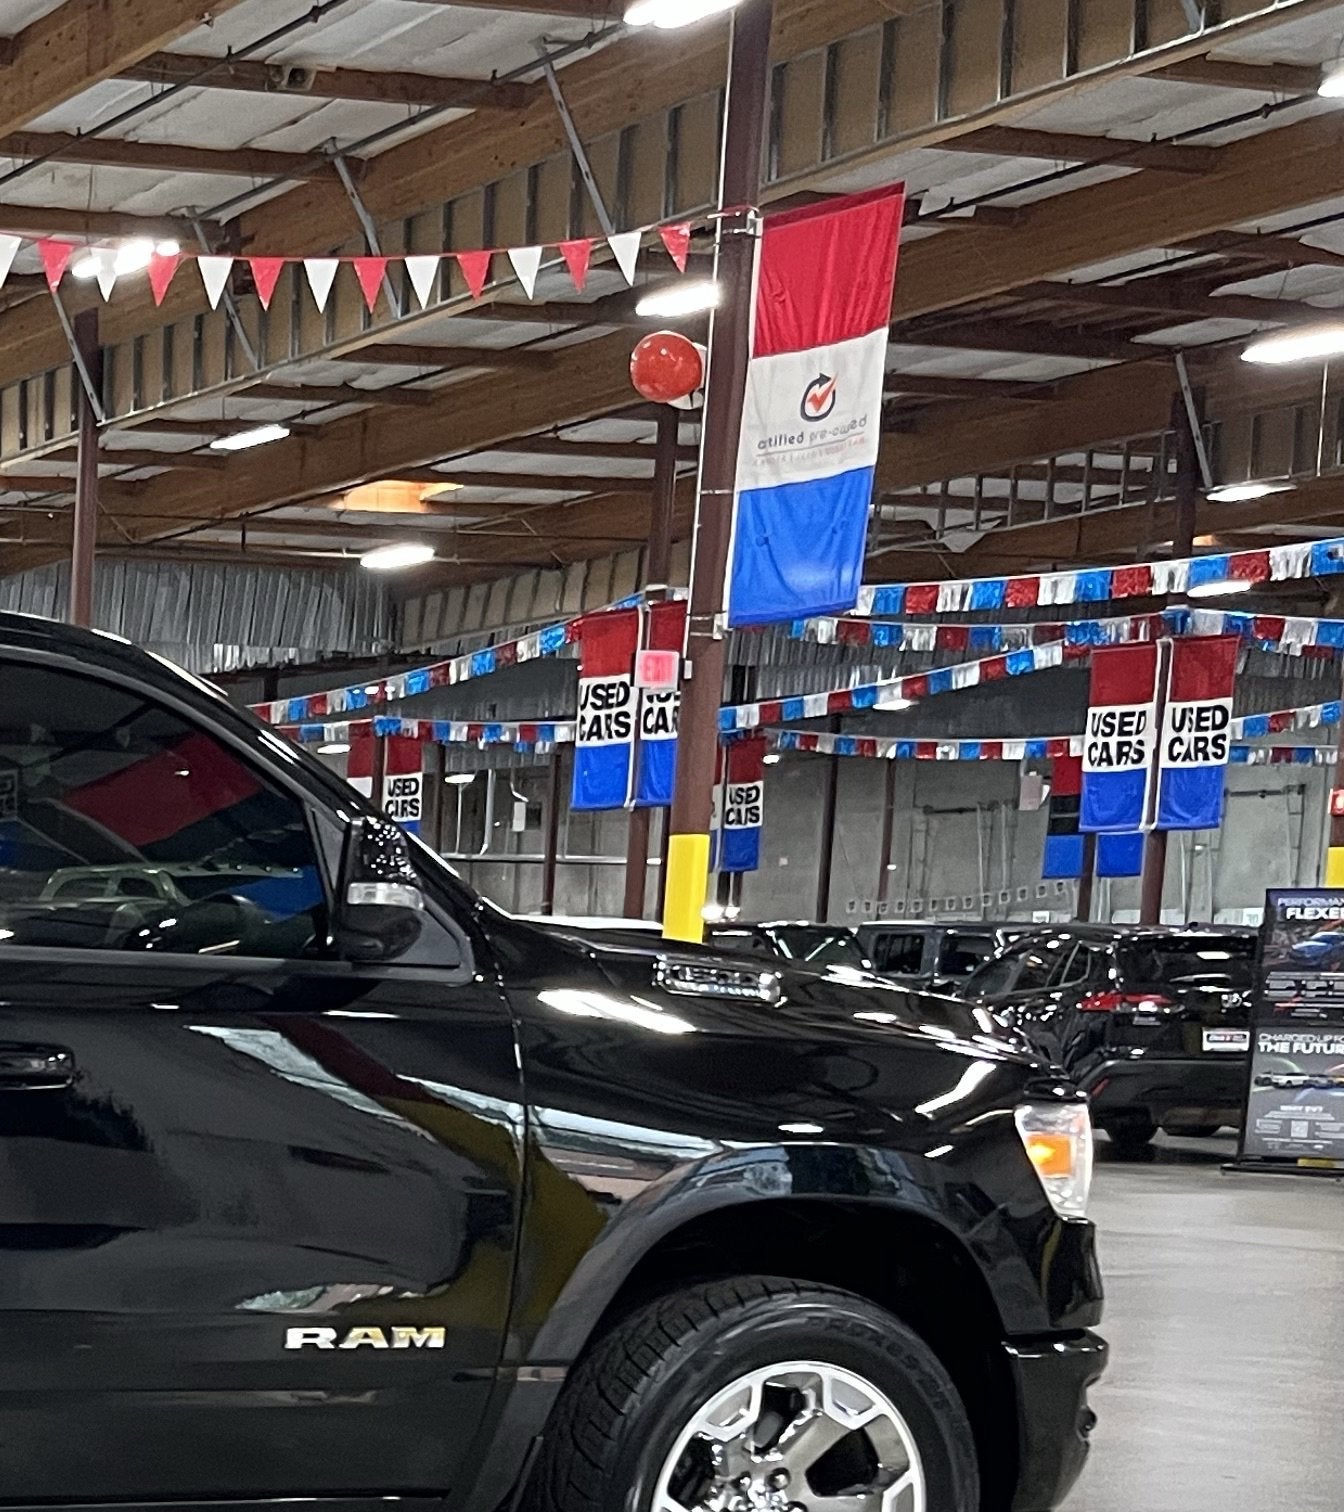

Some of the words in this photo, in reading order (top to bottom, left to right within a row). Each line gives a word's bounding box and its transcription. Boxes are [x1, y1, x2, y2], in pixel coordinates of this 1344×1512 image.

[580, 681, 630, 711] USED
[1092, 711, 1147, 737] USED
[1172, 705, 1229, 733] USED
[1088, 740, 1145, 767] CARS
[1168, 734, 1227, 762] CARS
[388, 778, 419, 797] USED
[1258, 1042, 1290, 1053] THE
[284, 1326, 446, 1349] RAM
